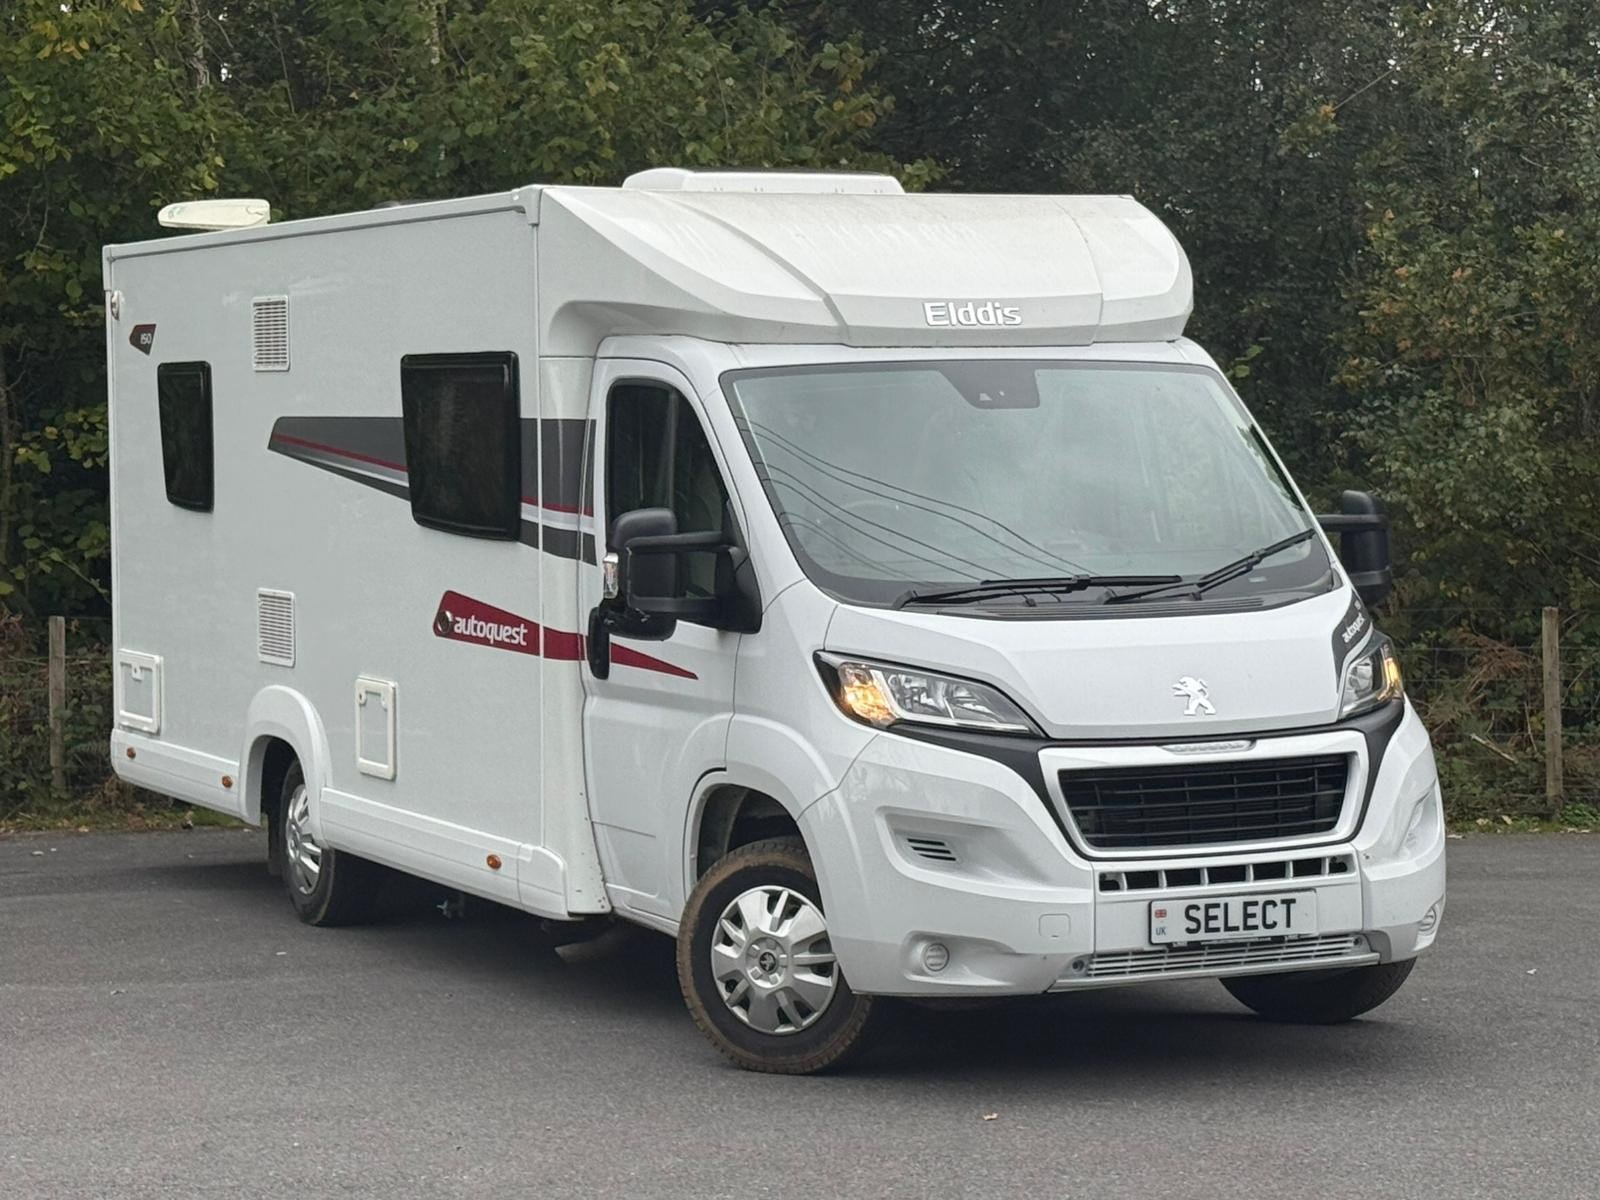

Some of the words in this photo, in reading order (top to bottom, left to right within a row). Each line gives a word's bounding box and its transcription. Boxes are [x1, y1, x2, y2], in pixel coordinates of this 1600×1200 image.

[922, 301, 1022, 326] Elddis
[454, 614, 528, 646] autoquest
[1184, 898, 1297, 934] SELECT
[1155, 927, 1167, 936] UK
